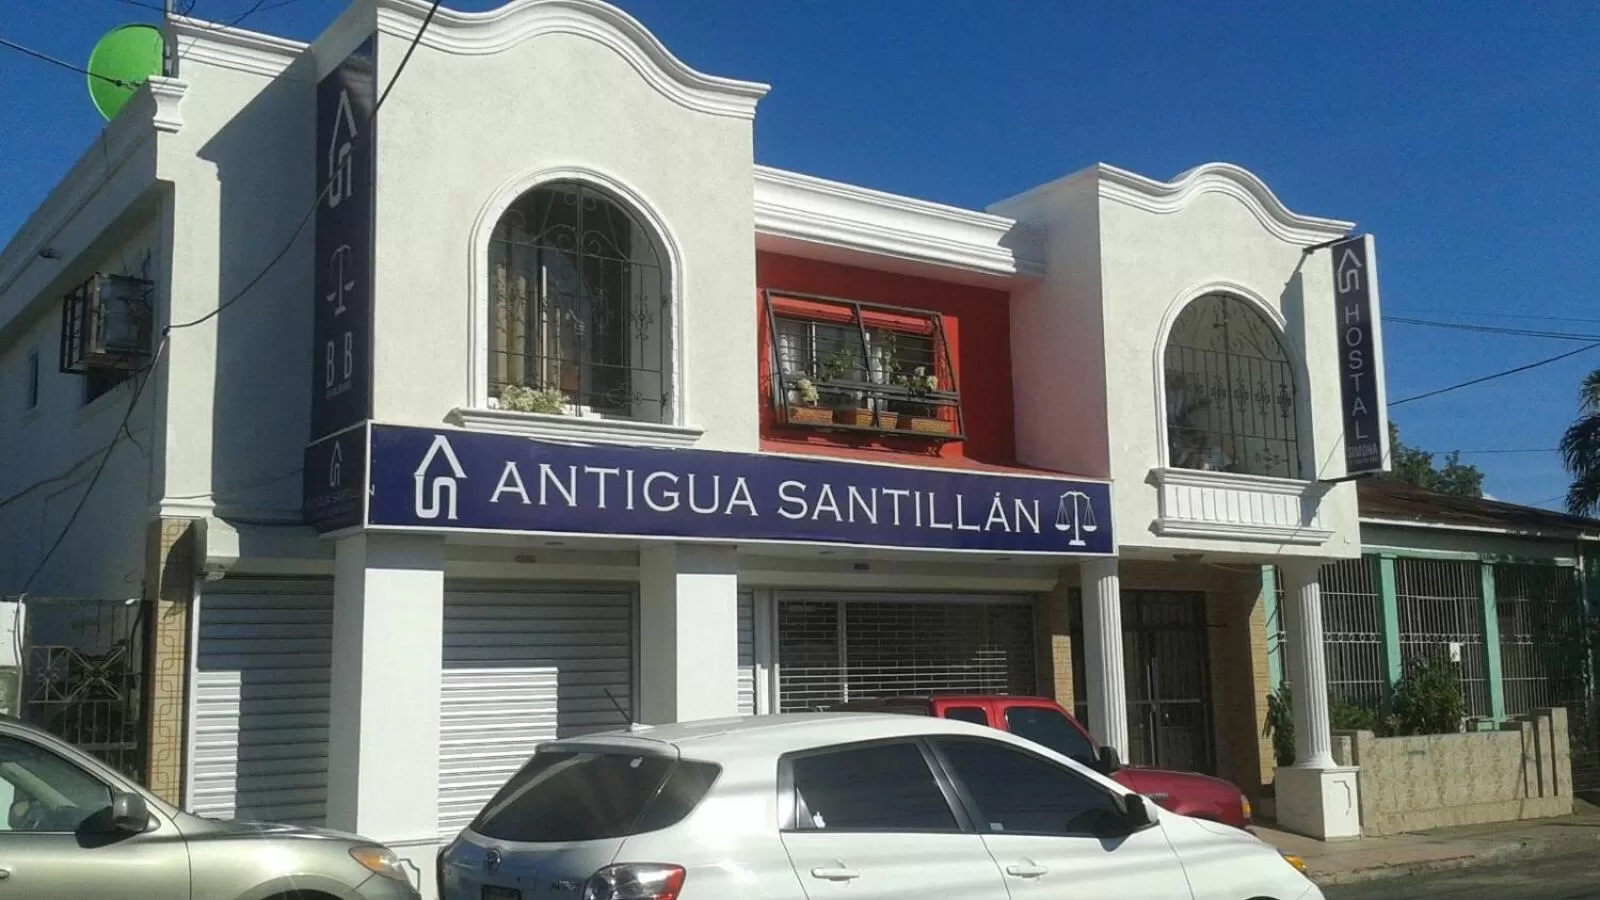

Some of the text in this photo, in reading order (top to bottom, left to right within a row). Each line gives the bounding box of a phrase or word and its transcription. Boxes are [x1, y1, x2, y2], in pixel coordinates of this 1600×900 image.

[1344, 303, 1369, 439] HOSTAL
[489, 460, 1041, 534] ANTIGUA SANTILLÁN
